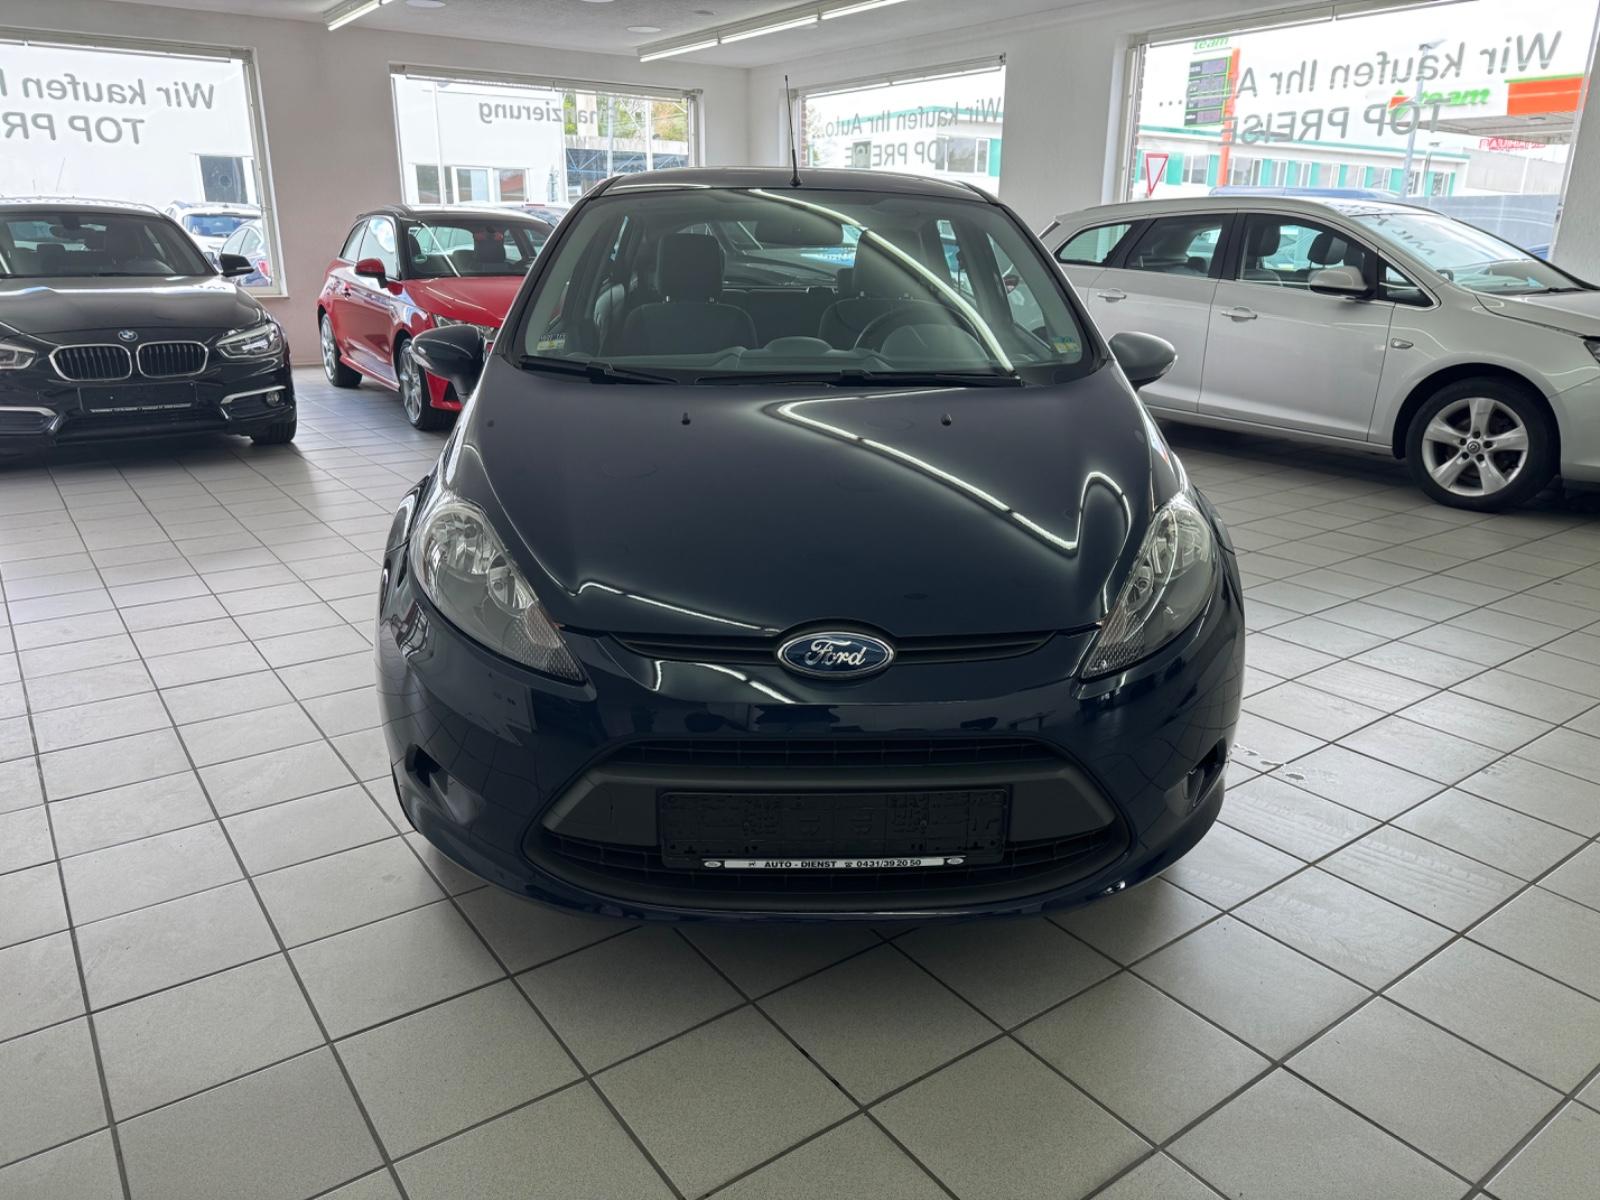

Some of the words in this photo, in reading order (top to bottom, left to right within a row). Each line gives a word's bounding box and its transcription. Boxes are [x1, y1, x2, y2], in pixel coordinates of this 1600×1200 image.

[804, 638, 867, 666] Ford
[764, 860, 792, 868] AUTO
[800, 860, 837, 868] DIENST
